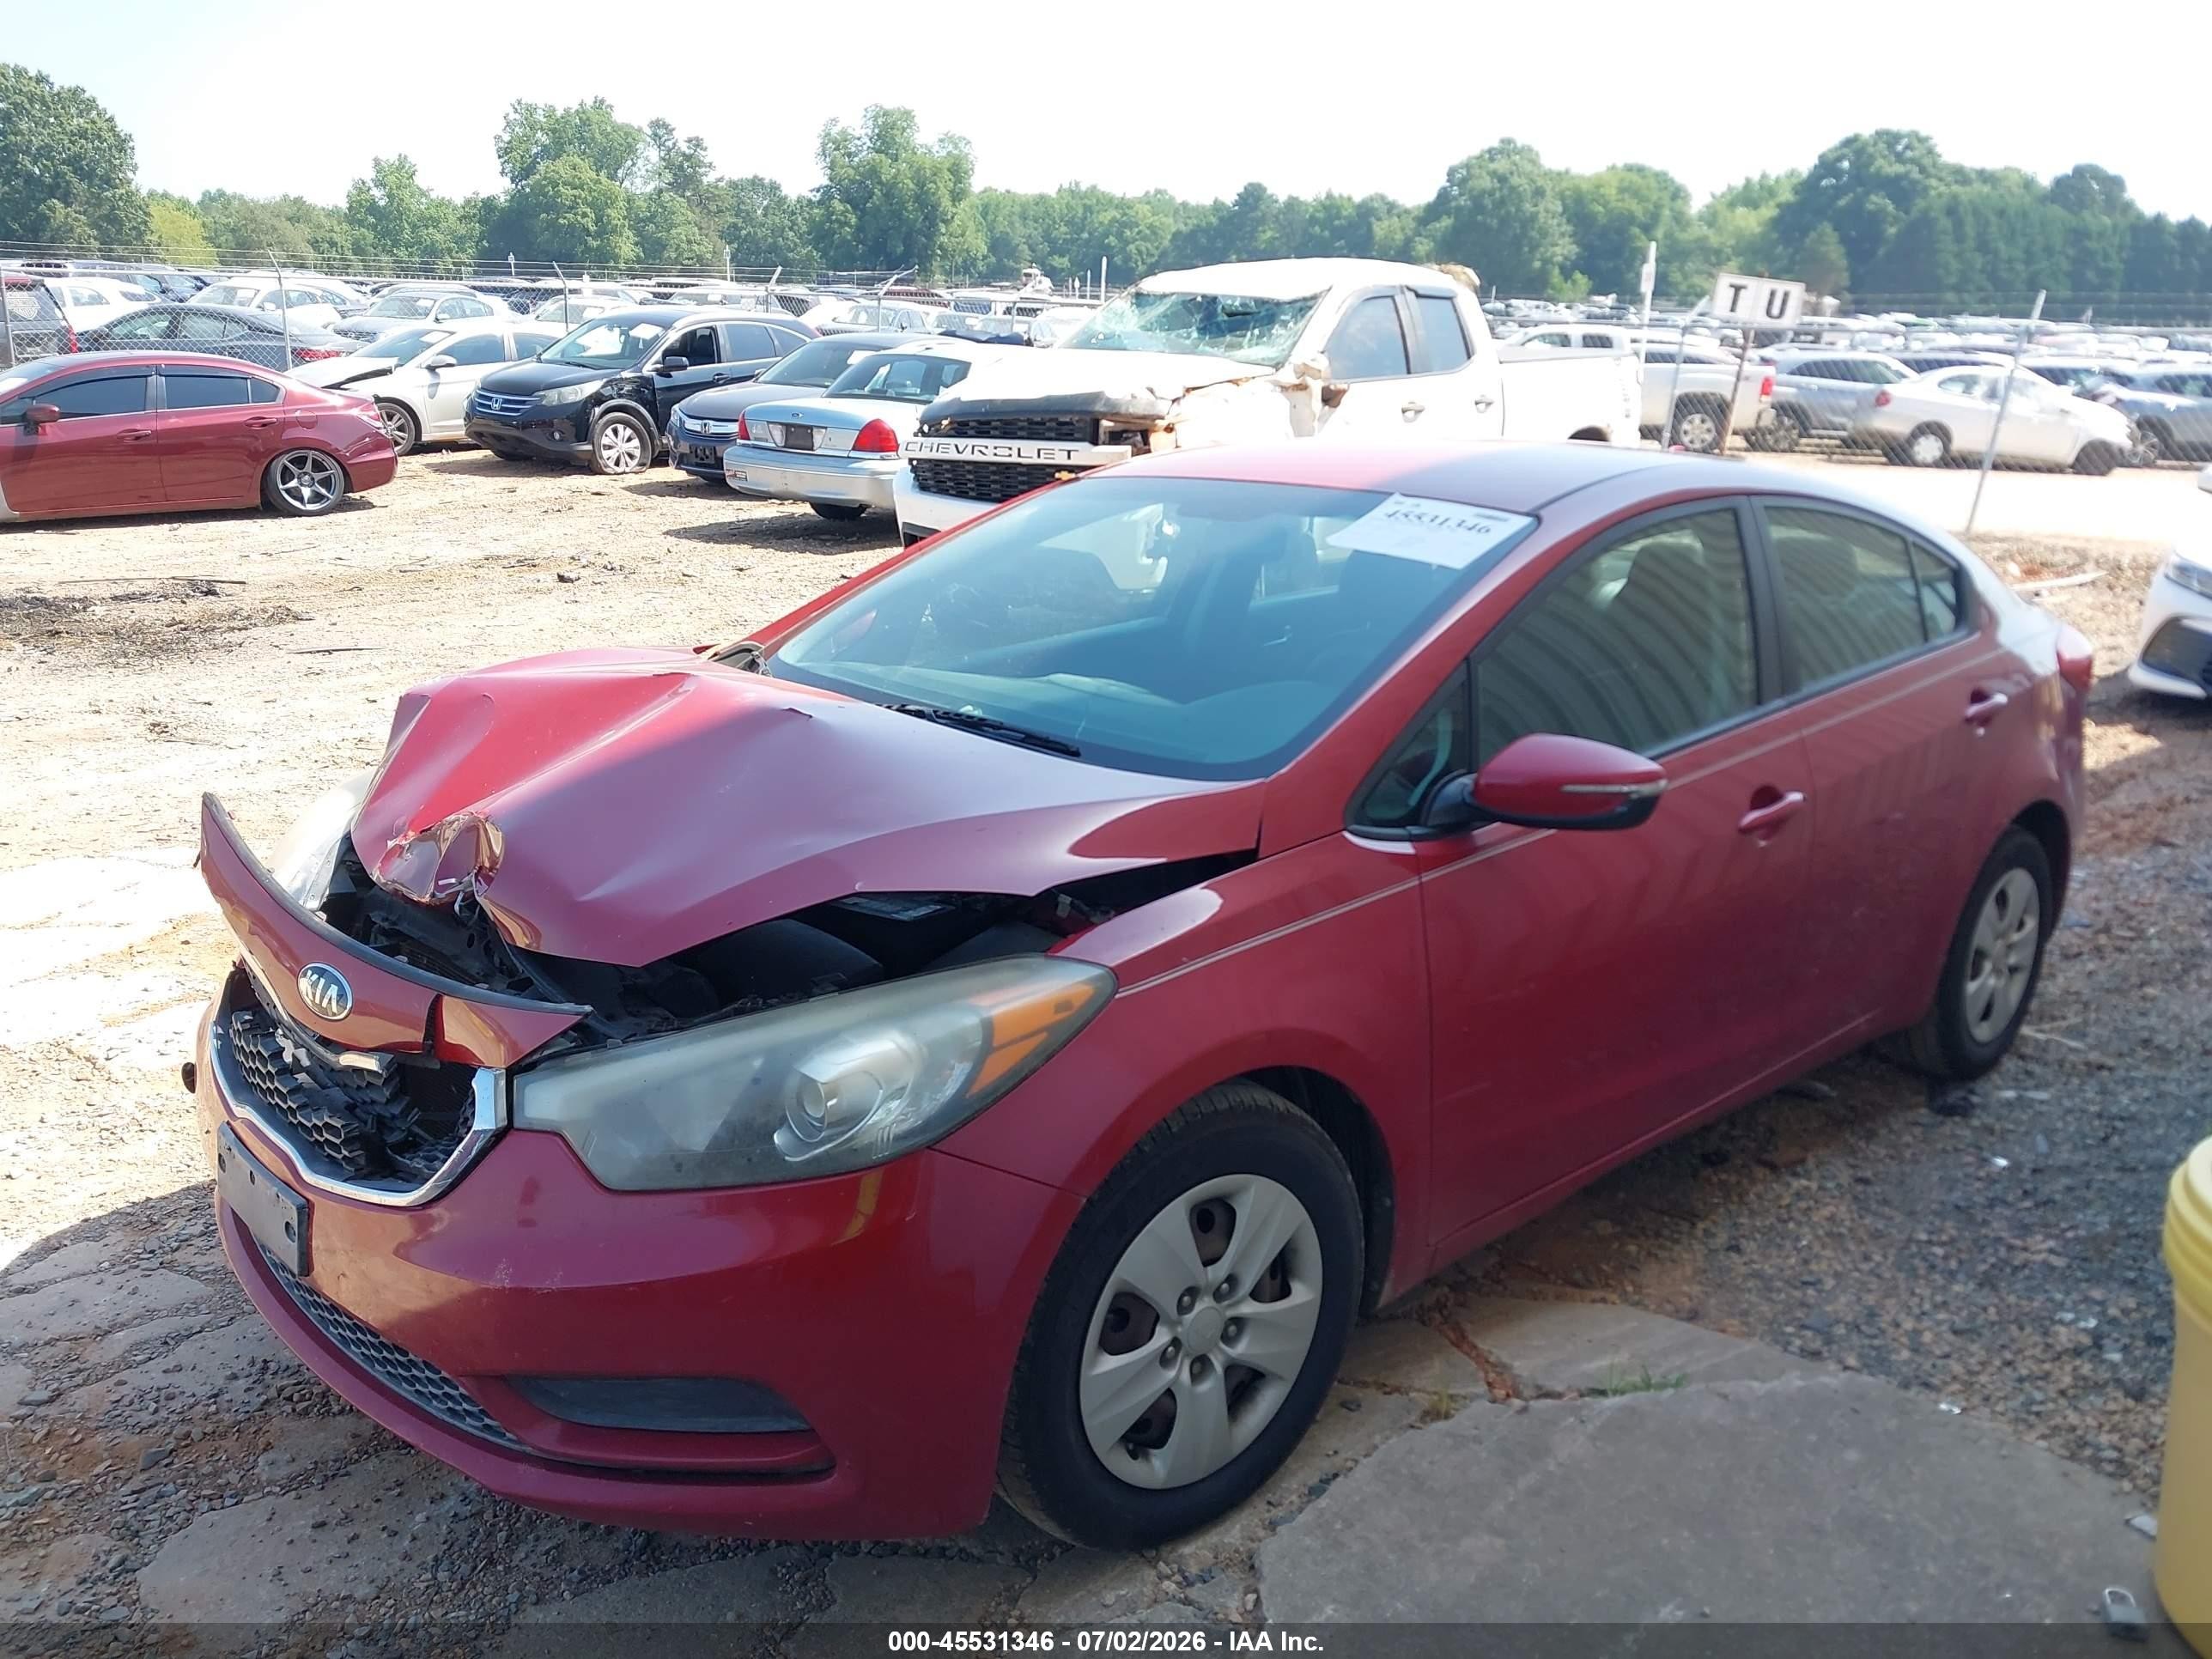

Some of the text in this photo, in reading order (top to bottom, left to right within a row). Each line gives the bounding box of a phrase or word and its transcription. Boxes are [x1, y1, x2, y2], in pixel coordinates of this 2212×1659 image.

[1729, 283, 1791, 319] T U
[904, 441, 1079, 460] CHEVROLET
[299, 969, 338, 1014] KIA
